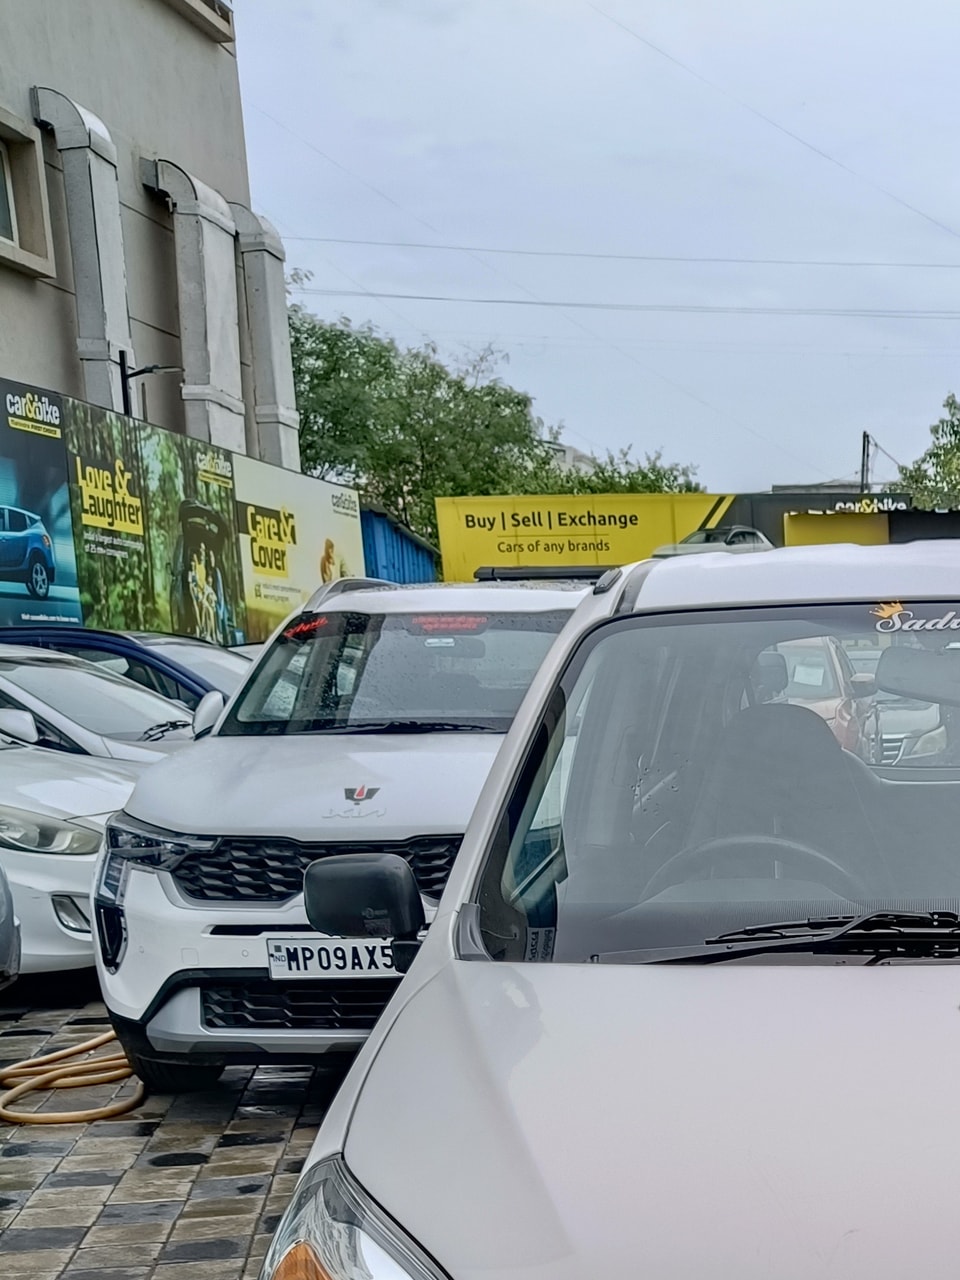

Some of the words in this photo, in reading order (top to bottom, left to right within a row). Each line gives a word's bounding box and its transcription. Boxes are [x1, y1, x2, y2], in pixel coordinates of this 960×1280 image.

[6, 392, 60, 425] car&bike
[76, 456, 112, 491] Love
[115, 459, 132, 497] &
[82, 487, 141, 527] Laughter
[247, 506, 278, 540] Care
[280, 505, 295, 544] &
[465, 513, 496, 531] Buy
[511, 512, 543, 528] Sell
[558, 511, 639, 529] Exchange
[250, 537, 287, 572] Cover
[497, 541, 524, 553] Cars
[527, 541, 540, 552] of
[543, 542, 565, 554] any
[568, 539, 610, 552] brands
